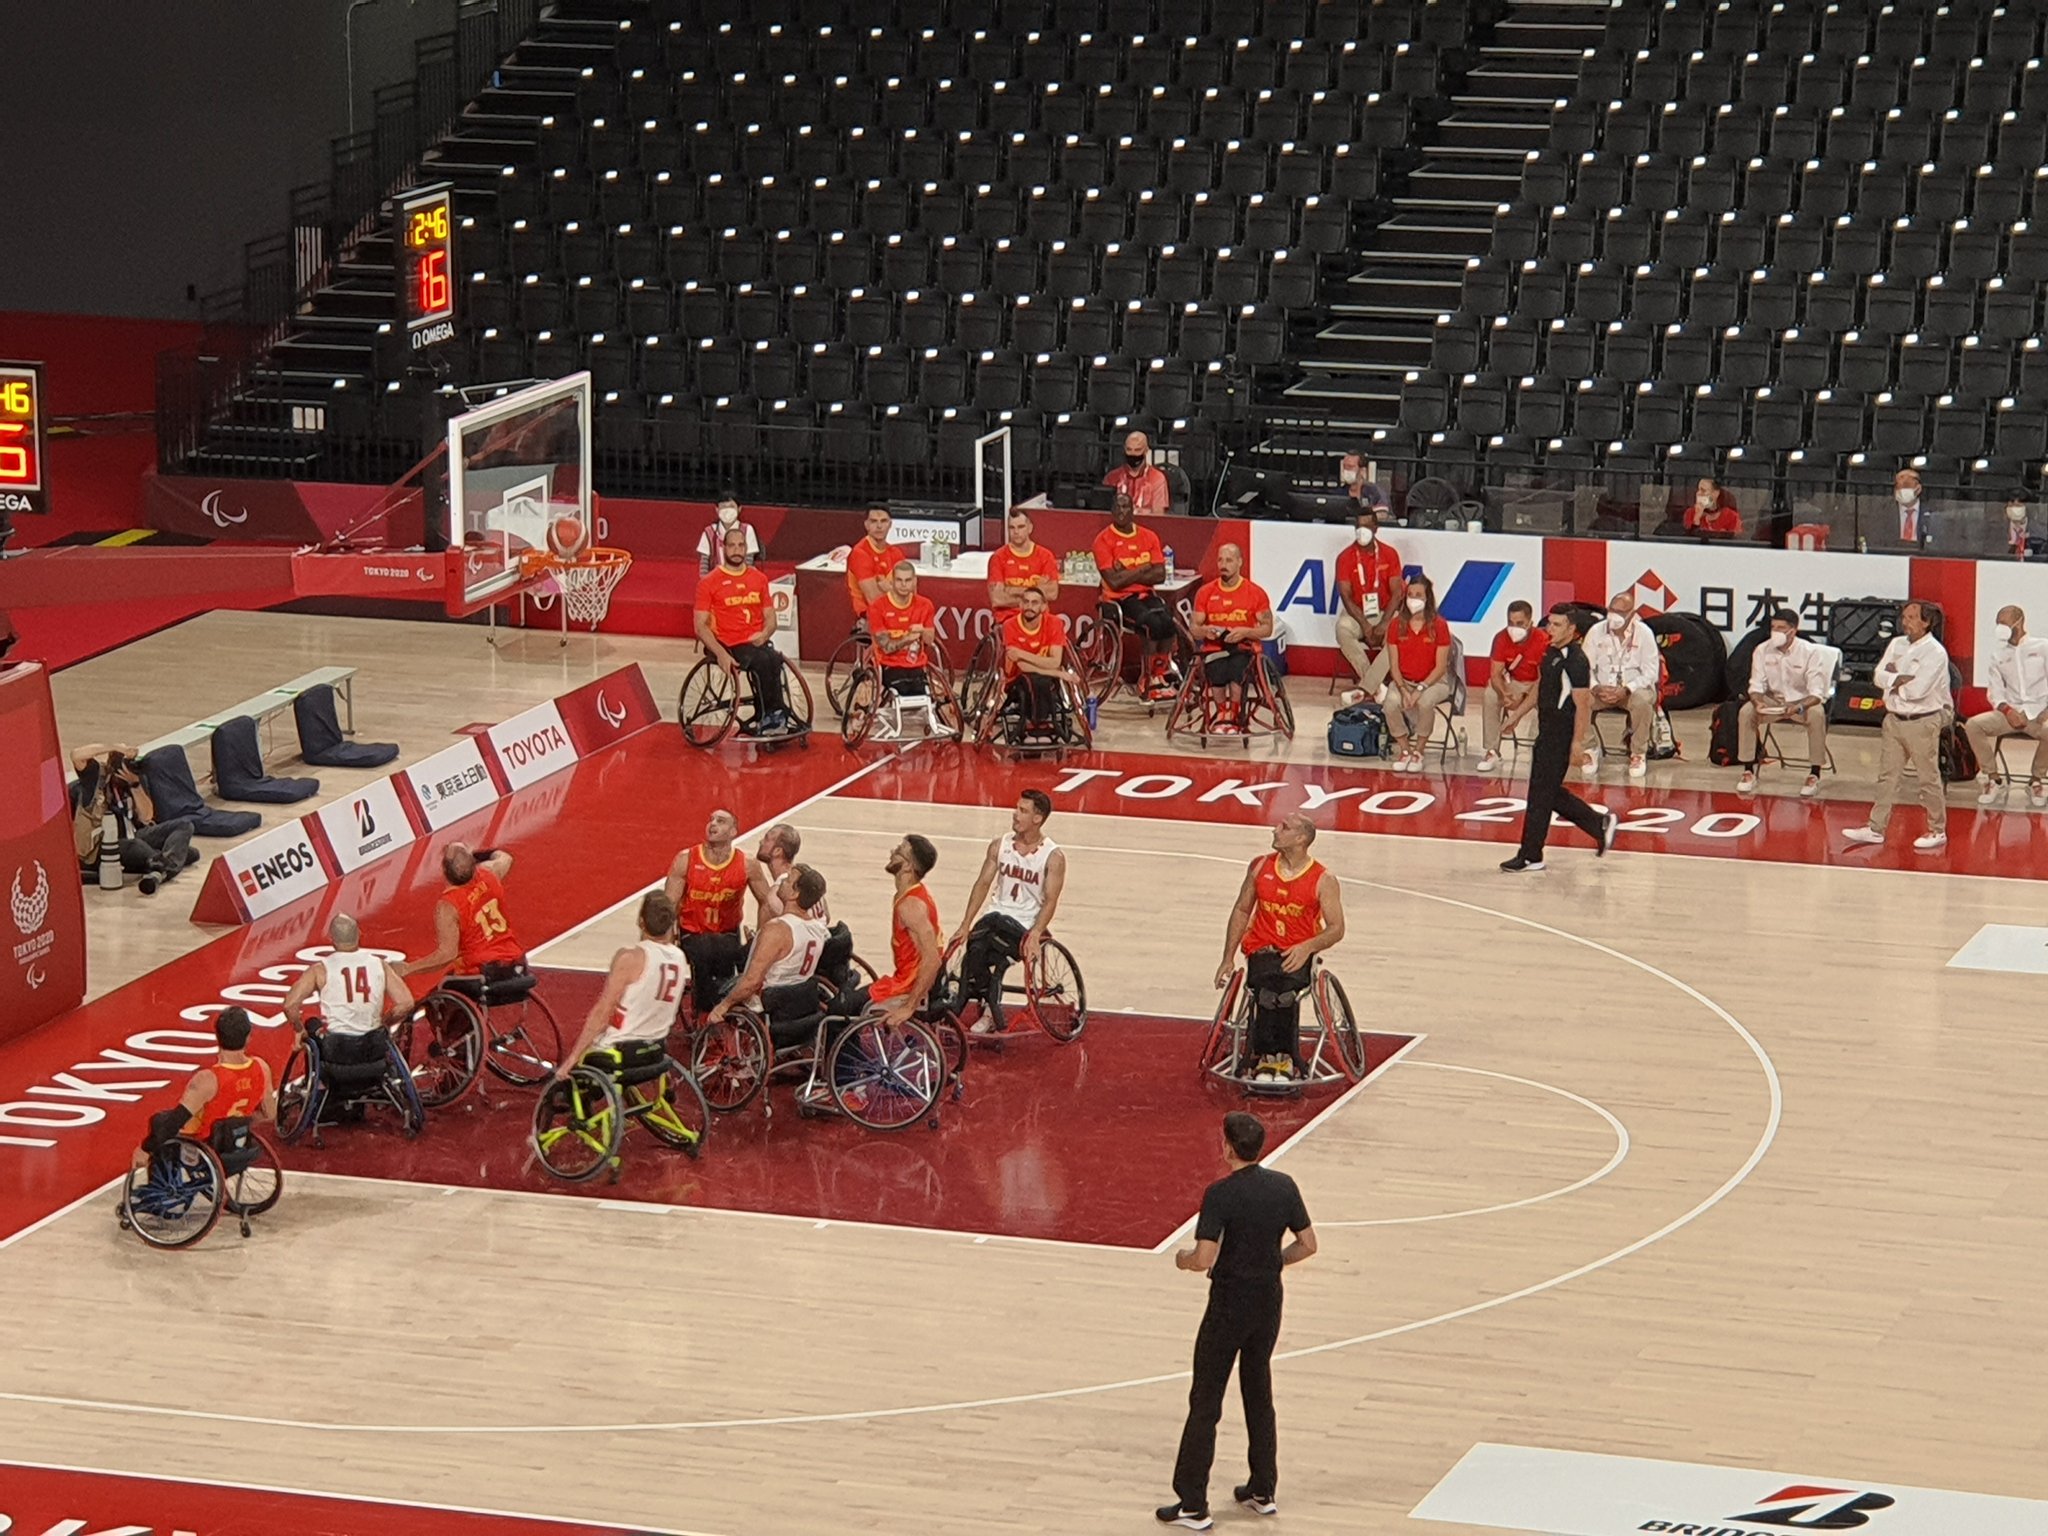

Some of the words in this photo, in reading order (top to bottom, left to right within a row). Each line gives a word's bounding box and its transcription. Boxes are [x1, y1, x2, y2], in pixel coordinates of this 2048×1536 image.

[422, 250, 447, 309] 16
[422, 321, 454, 345] OMEGA
[895, 527, 930, 539] TOKYO
[932, 529, 958, 541] 2020
[363, 566, 390, 578] TOKYO
[390, 567, 409, 578] 2020
[502, 725, 566, 769] TOYOTA
[1053, 768, 1436, 816] TOKYO
[1455, 797, 1761, 838] 220
[251, 842, 314, 891] ENEOS
[999, 861, 1040, 886] CANADA
[1010, 882, 1020, 902] 4
[474, 898, 507, 941] 13
[800, 940, 817, 976] 6
[341, 967, 371, 1003] 14
[656, 963, 679, 1003] 12
